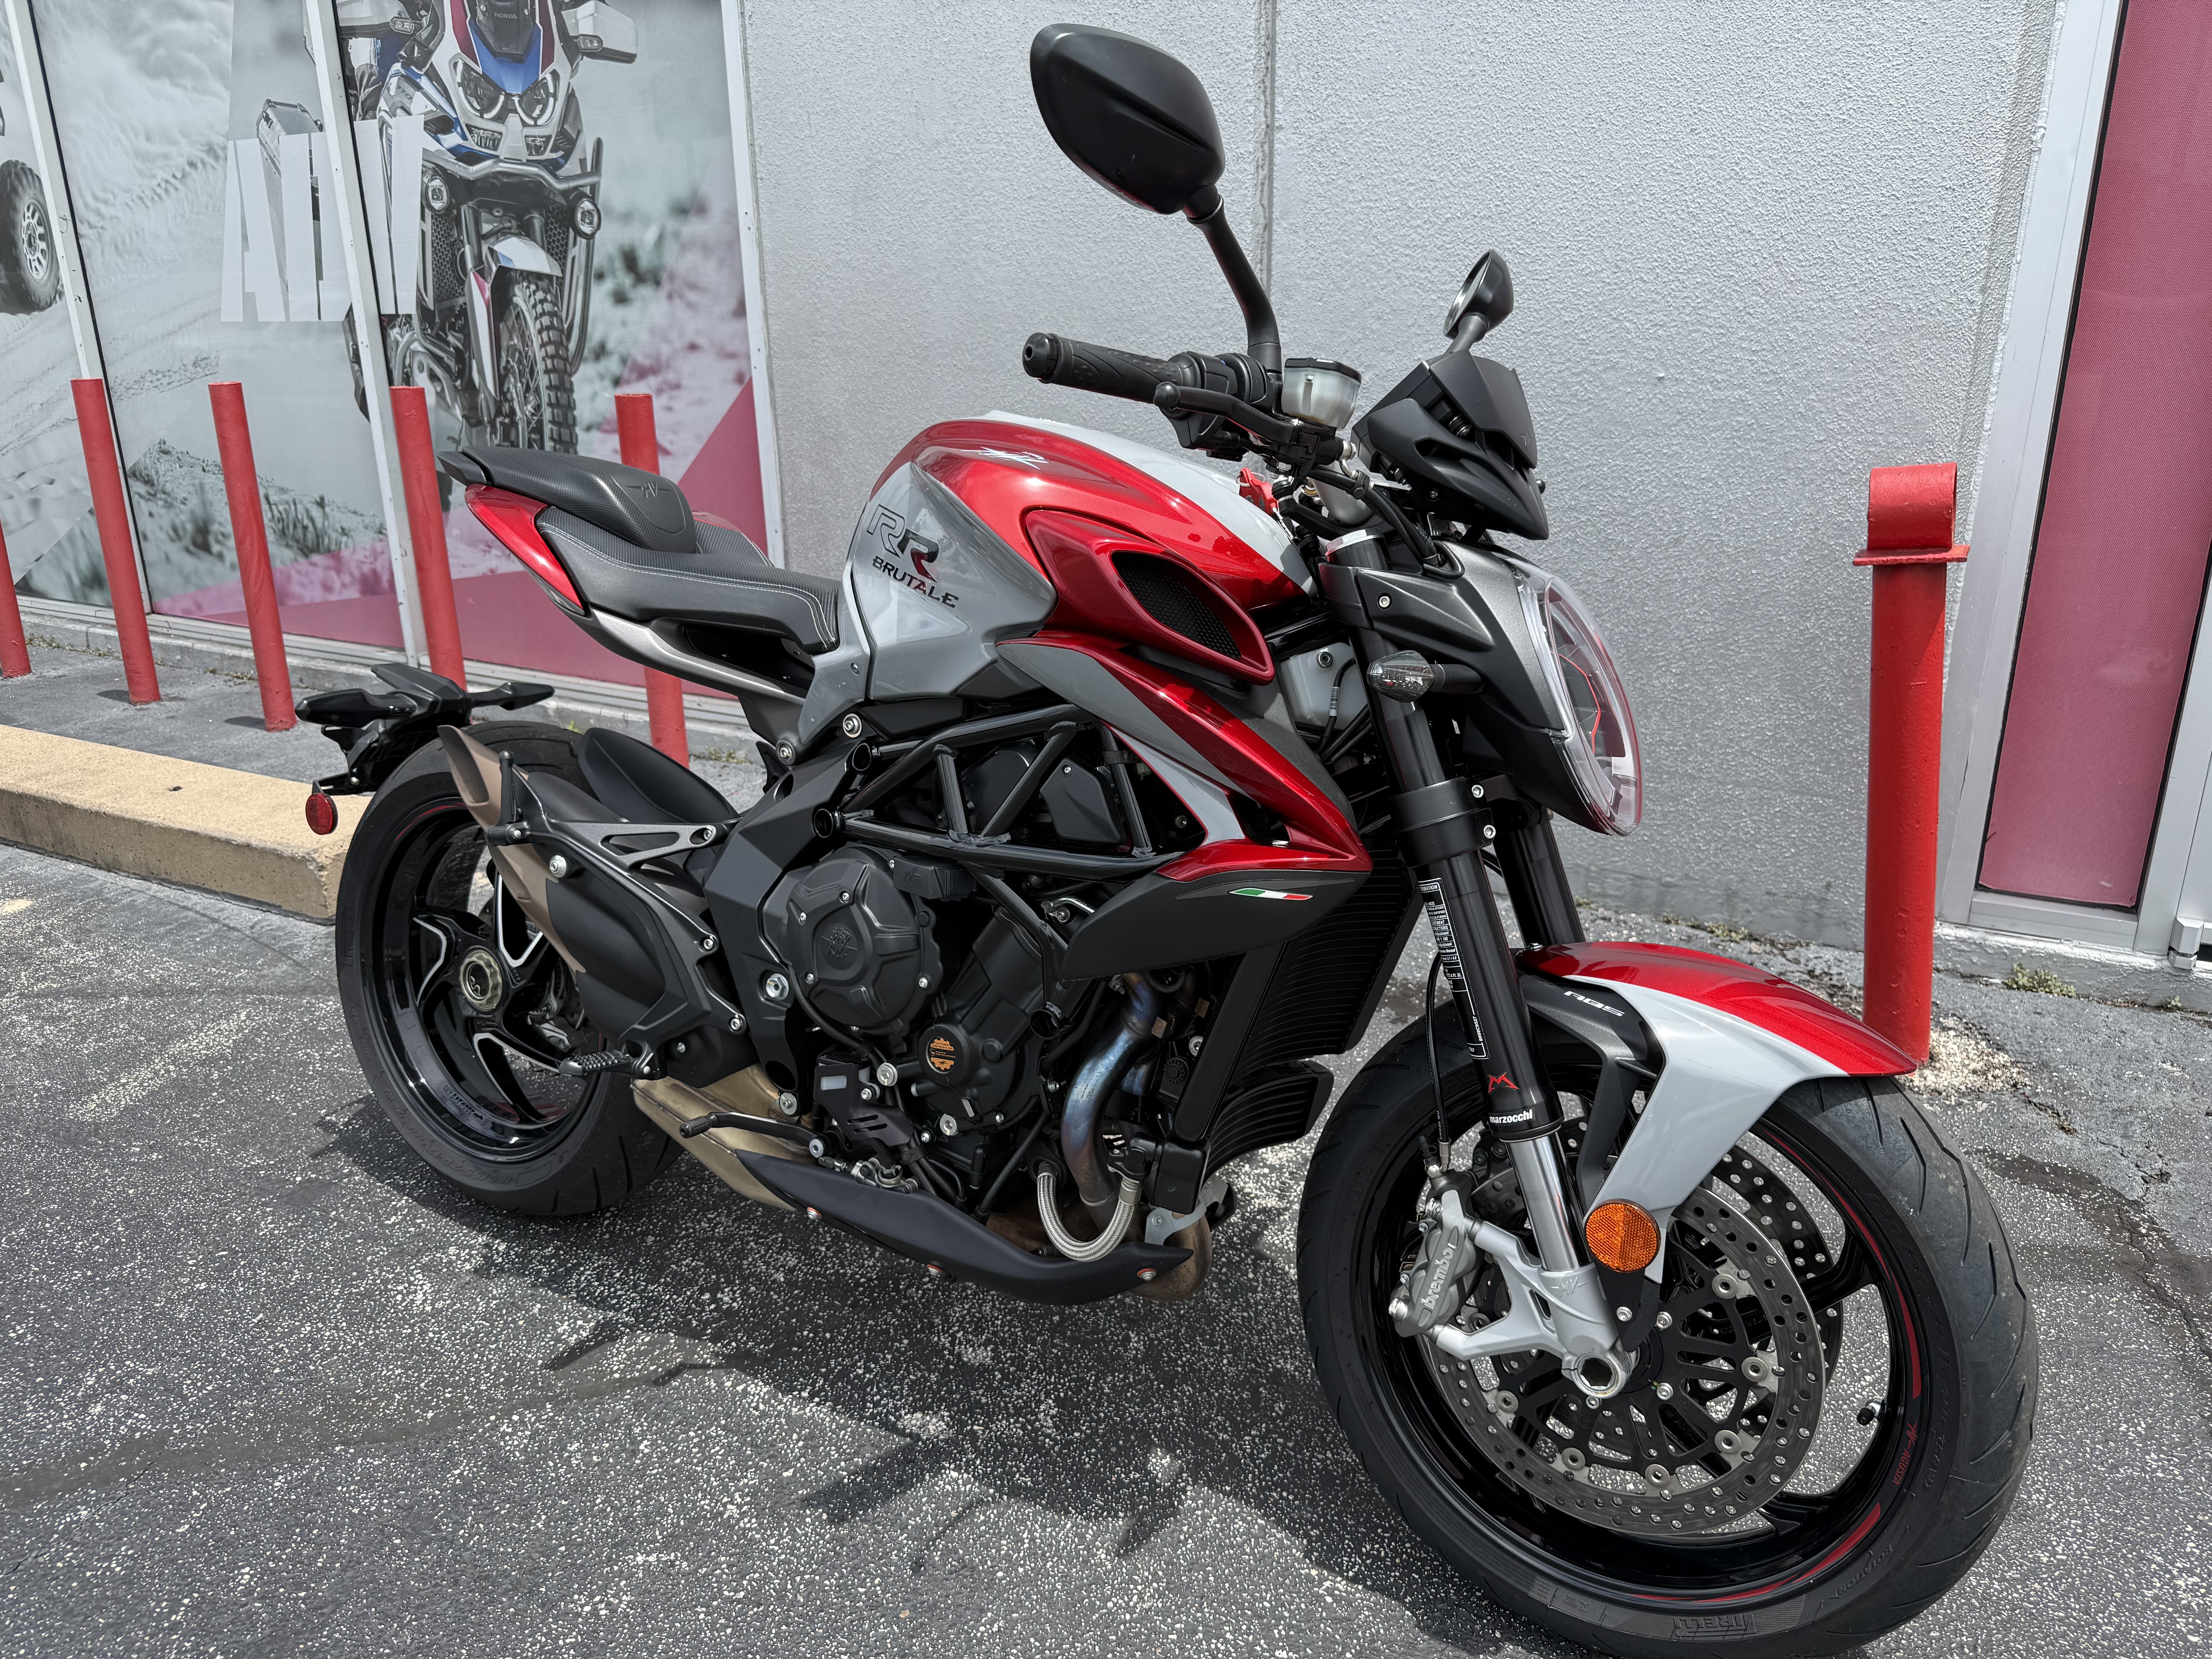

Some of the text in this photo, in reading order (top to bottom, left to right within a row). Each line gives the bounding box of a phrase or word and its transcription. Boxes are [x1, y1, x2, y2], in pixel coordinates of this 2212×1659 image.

[872, 555, 959, 608] BRUTALE
[1564, 991, 1625, 1017] ABS
[1489, 1109, 1532, 1124] marzocchi
[1420, 1248, 1454, 1310] brembo
[1892, 1448, 1911, 1486] AGUSTA
